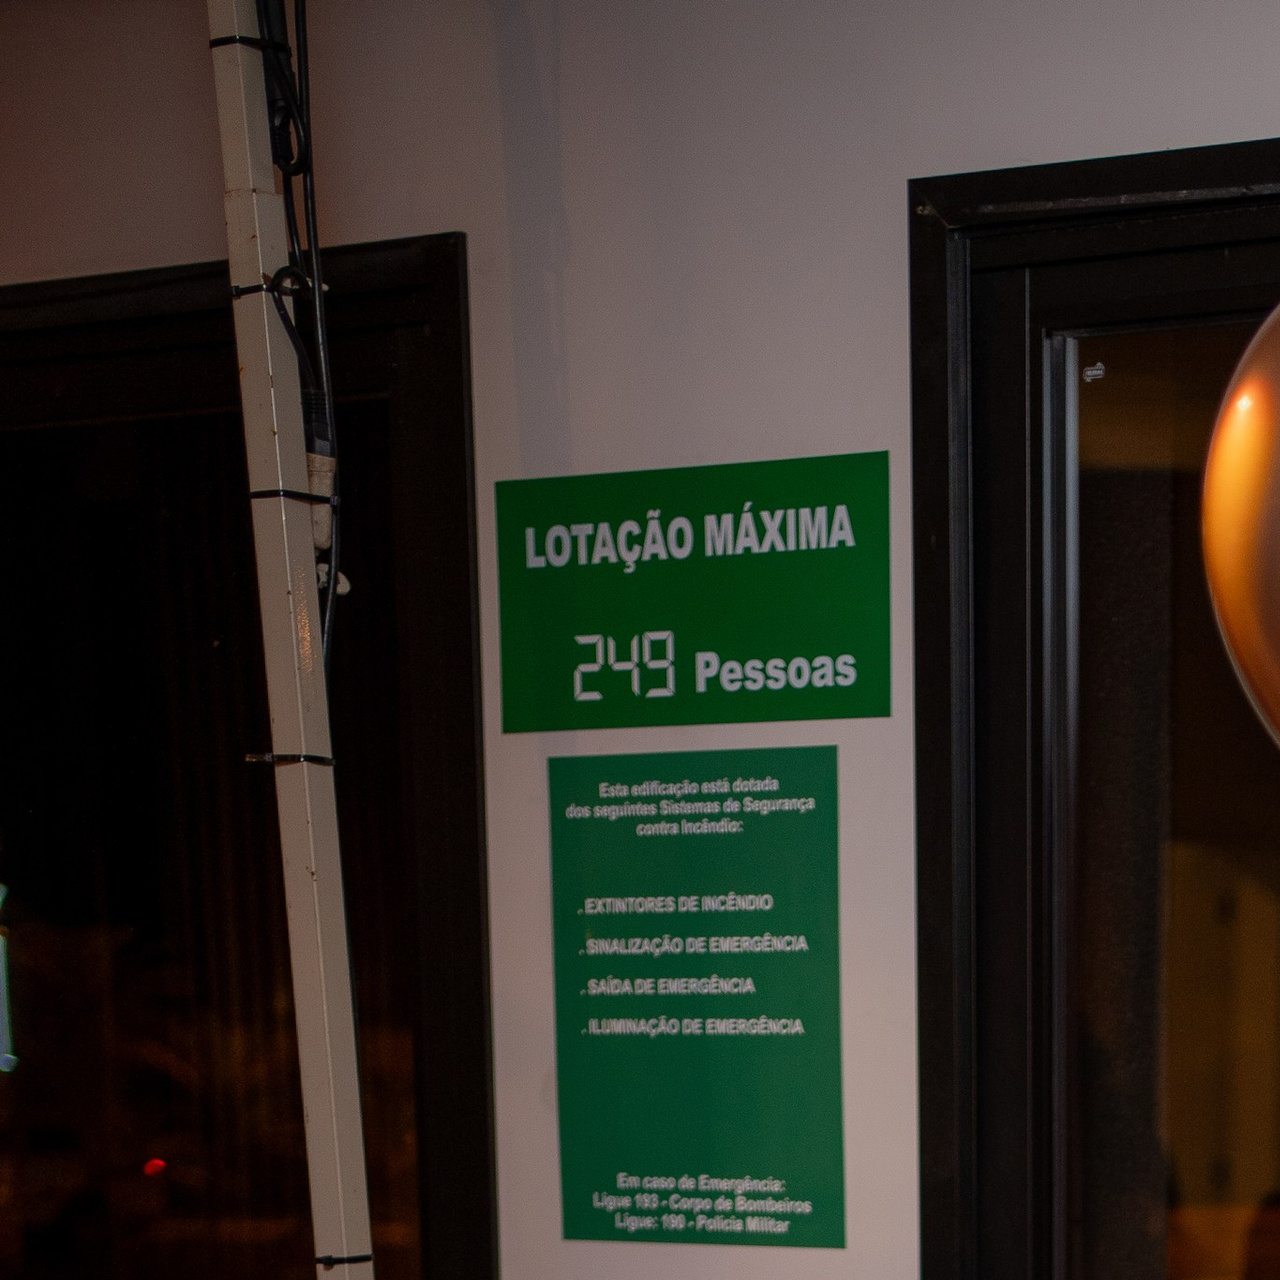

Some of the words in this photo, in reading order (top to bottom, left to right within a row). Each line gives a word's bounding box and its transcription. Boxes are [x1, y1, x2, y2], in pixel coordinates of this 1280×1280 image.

[525, 509, 694, 573] LOTAÇÃO
[704, 501, 856, 556] MÁXIMA
[573, 630, 675, 700] 249
[695, 651, 857, 693] Pessoas
[599, 782, 628, 798] Esta
[631, 779, 699, 798] edificação
[732, 776, 779, 792] dotada
[566, 804, 591, 819] dos
[594, 802, 657, 821] seguintes
[659, 799, 721, 816] Sistemas
[723, 797, 741, 814] de
[743, 796, 816, 816] Segurança
[636, 821, 679, 836] contra
[678, 895, 699, 913] DE
[701, 891, 773, 912] INCÊNDIO
[685, 936, 707, 953] DE
[709, 932, 809, 953] EMERGÊNCIA
[634, 978, 656, 994] DE
[658, 974, 756, 994] EMERGÊNCIA
[682, 1018, 703, 1034] DE
[705, 1015, 805, 1034] EMERGÊNCIA
[617, 1172, 640, 1189] Em
[642, 1177, 676, 1190] caso
[677, 1175, 696, 1191] de
[593, 1192, 632, 1211] Ligue
[669, 1194, 712, 1214] Corpo
[714, 1196, 733, 1212] de
[735, 1195, 812, 1213] Bombeiros
[746, 1216, 790, 1233] Militar
